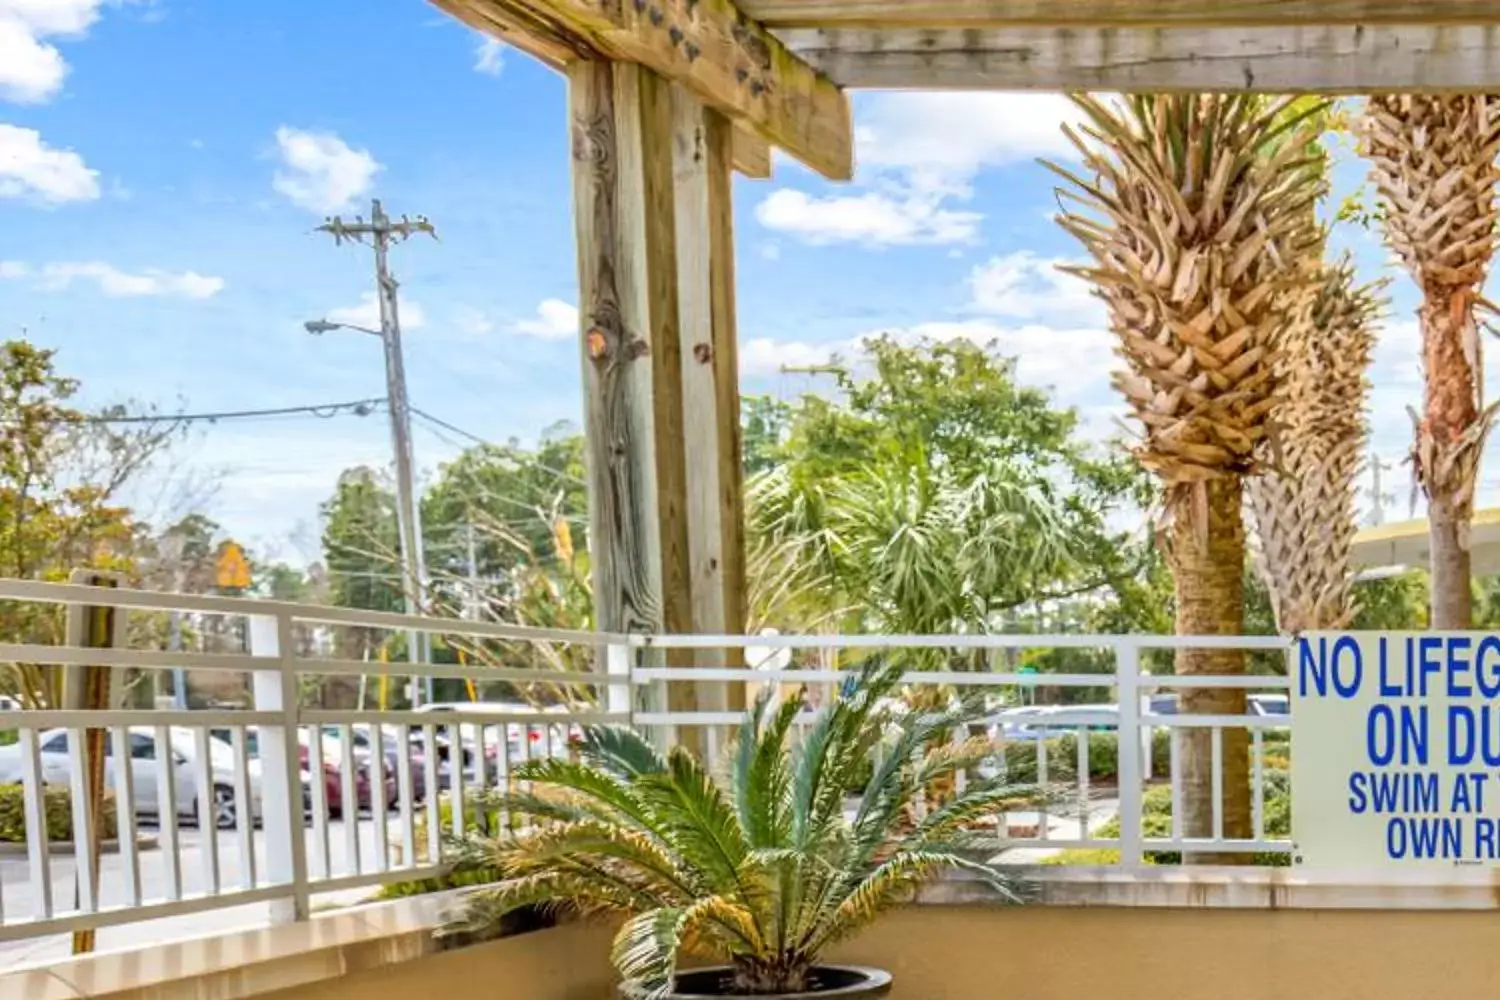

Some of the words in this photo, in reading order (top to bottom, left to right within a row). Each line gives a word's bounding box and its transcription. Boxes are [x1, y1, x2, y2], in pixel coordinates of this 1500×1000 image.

[1299, 635, 1363, 699] NO
[1366, 704, 1429, 767] ON
[1348, 772, 1440, 815] SWIM
[1450, 772, 1489, 814] AT
[1386, 817, 1463, 860] OWN
